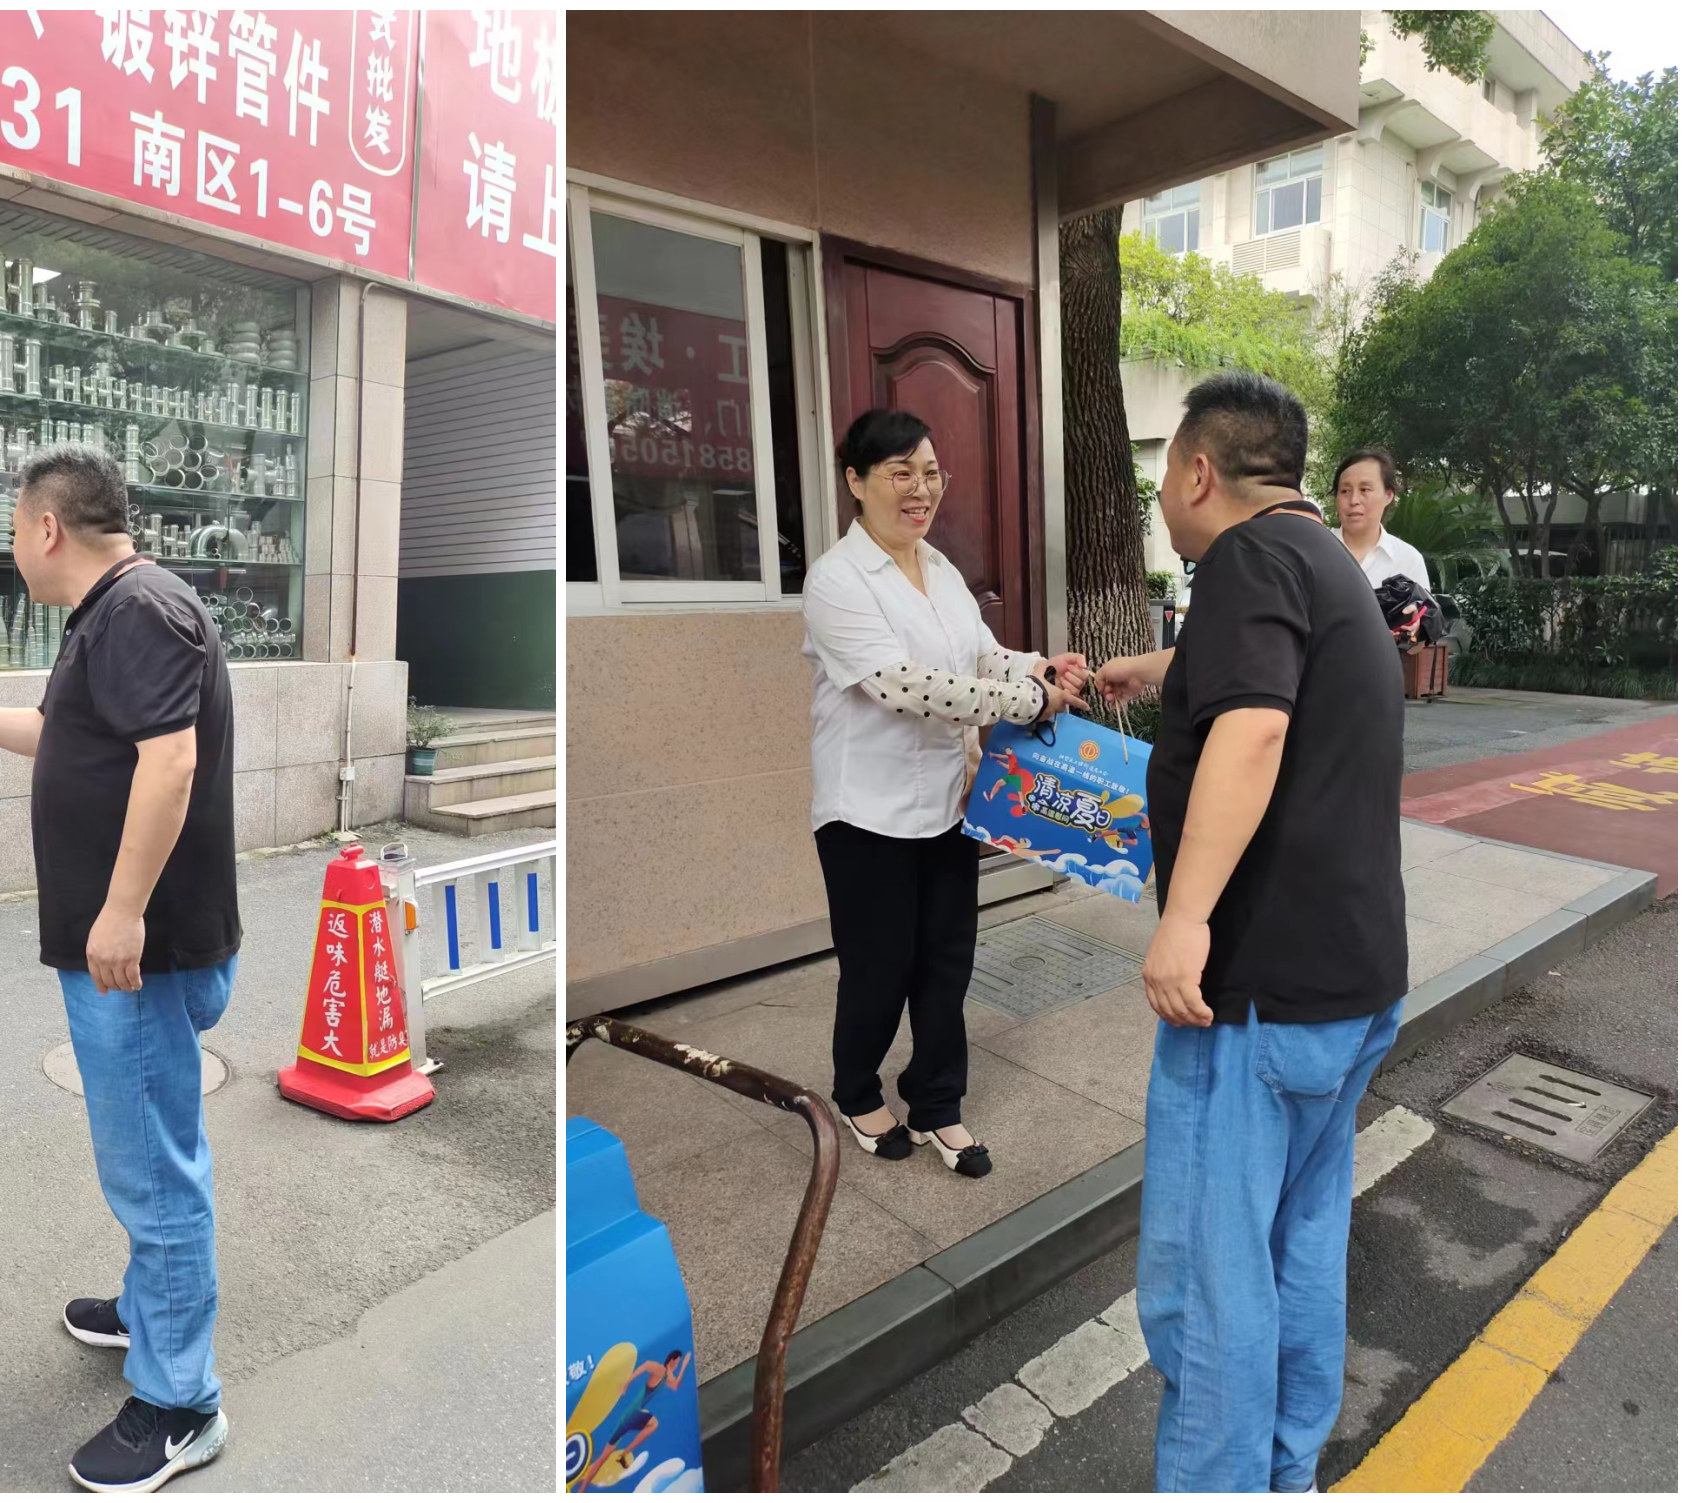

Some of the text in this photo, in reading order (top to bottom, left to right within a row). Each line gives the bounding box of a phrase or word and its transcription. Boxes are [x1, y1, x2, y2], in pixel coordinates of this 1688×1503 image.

[129, 110, 377, 257] 南区1-6号
[320, 912, 350, 1057] 返味危害大
[368, 911, 394, 1032] 潜水艇地漏
